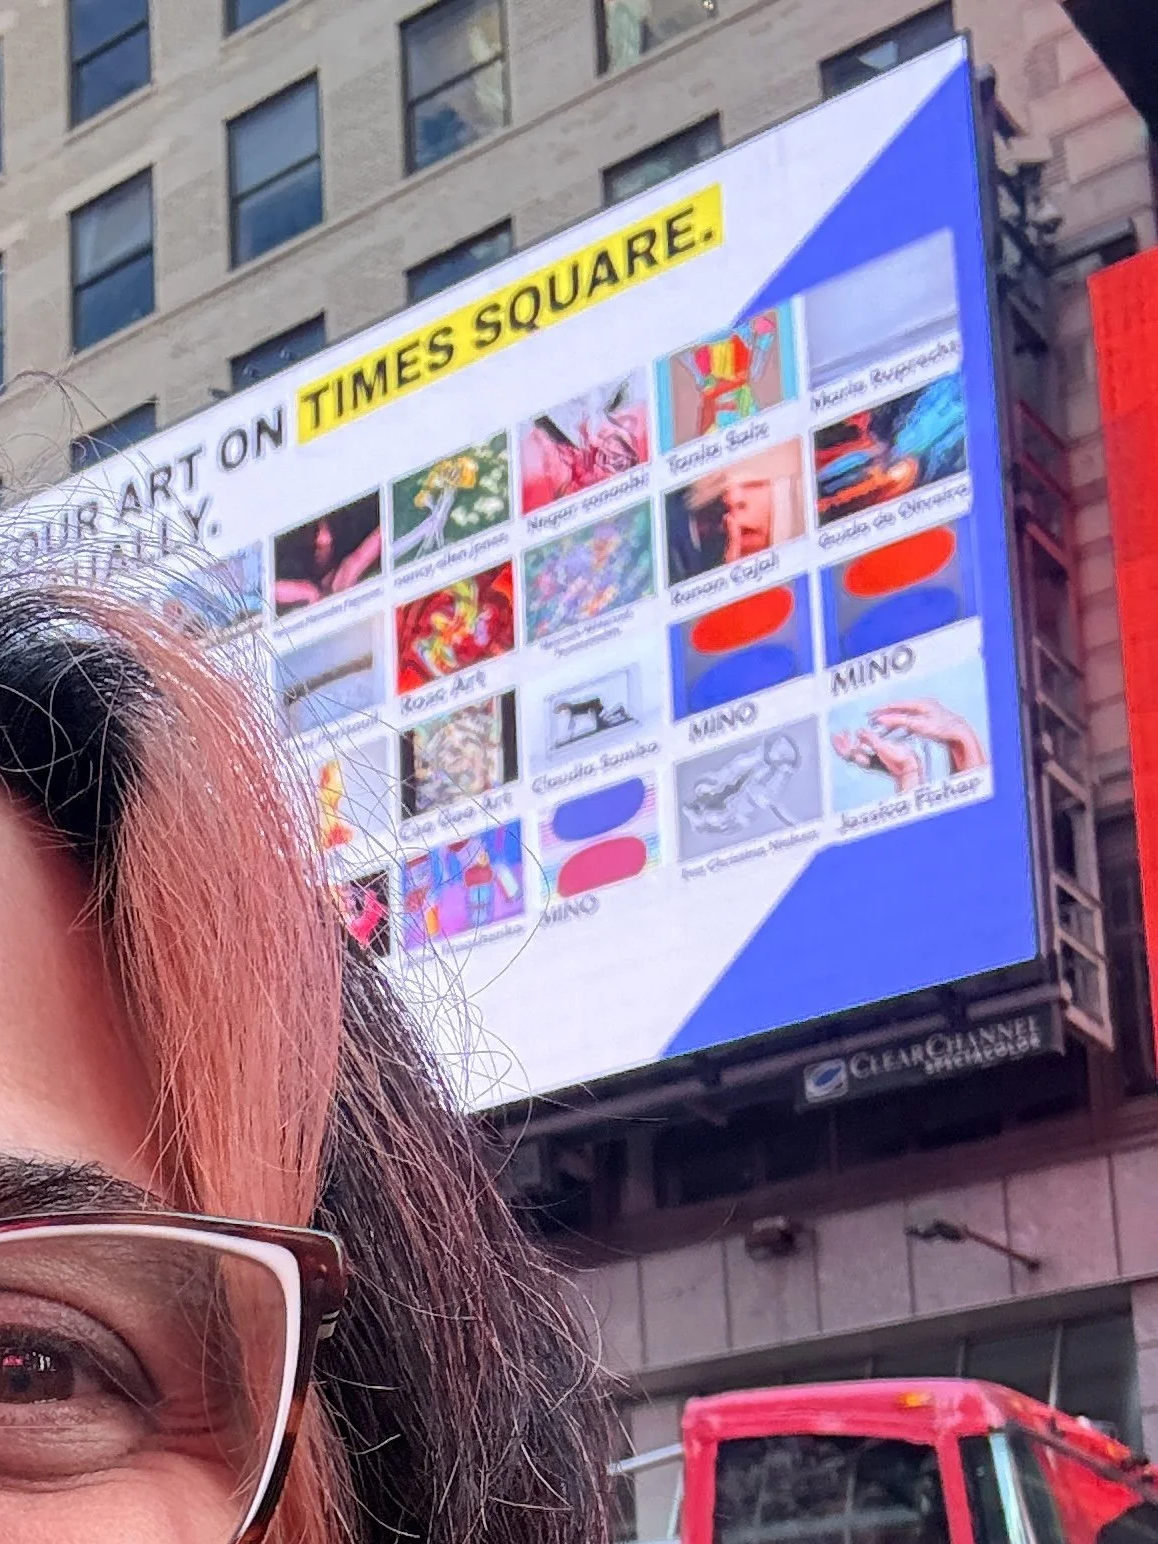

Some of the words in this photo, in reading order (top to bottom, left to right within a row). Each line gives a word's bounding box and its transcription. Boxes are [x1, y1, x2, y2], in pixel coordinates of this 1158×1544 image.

[120, 443, 207, 523] ART
[218, 406, 286, 472] ON
[300, 326, 455, 432] TIMES
[473, 206, 715, 351] SQUARE.
[828, 644, 917, 697] MINO
[687, 701, 760, 743] MINO
[541, 893, 602, 931] MINO
